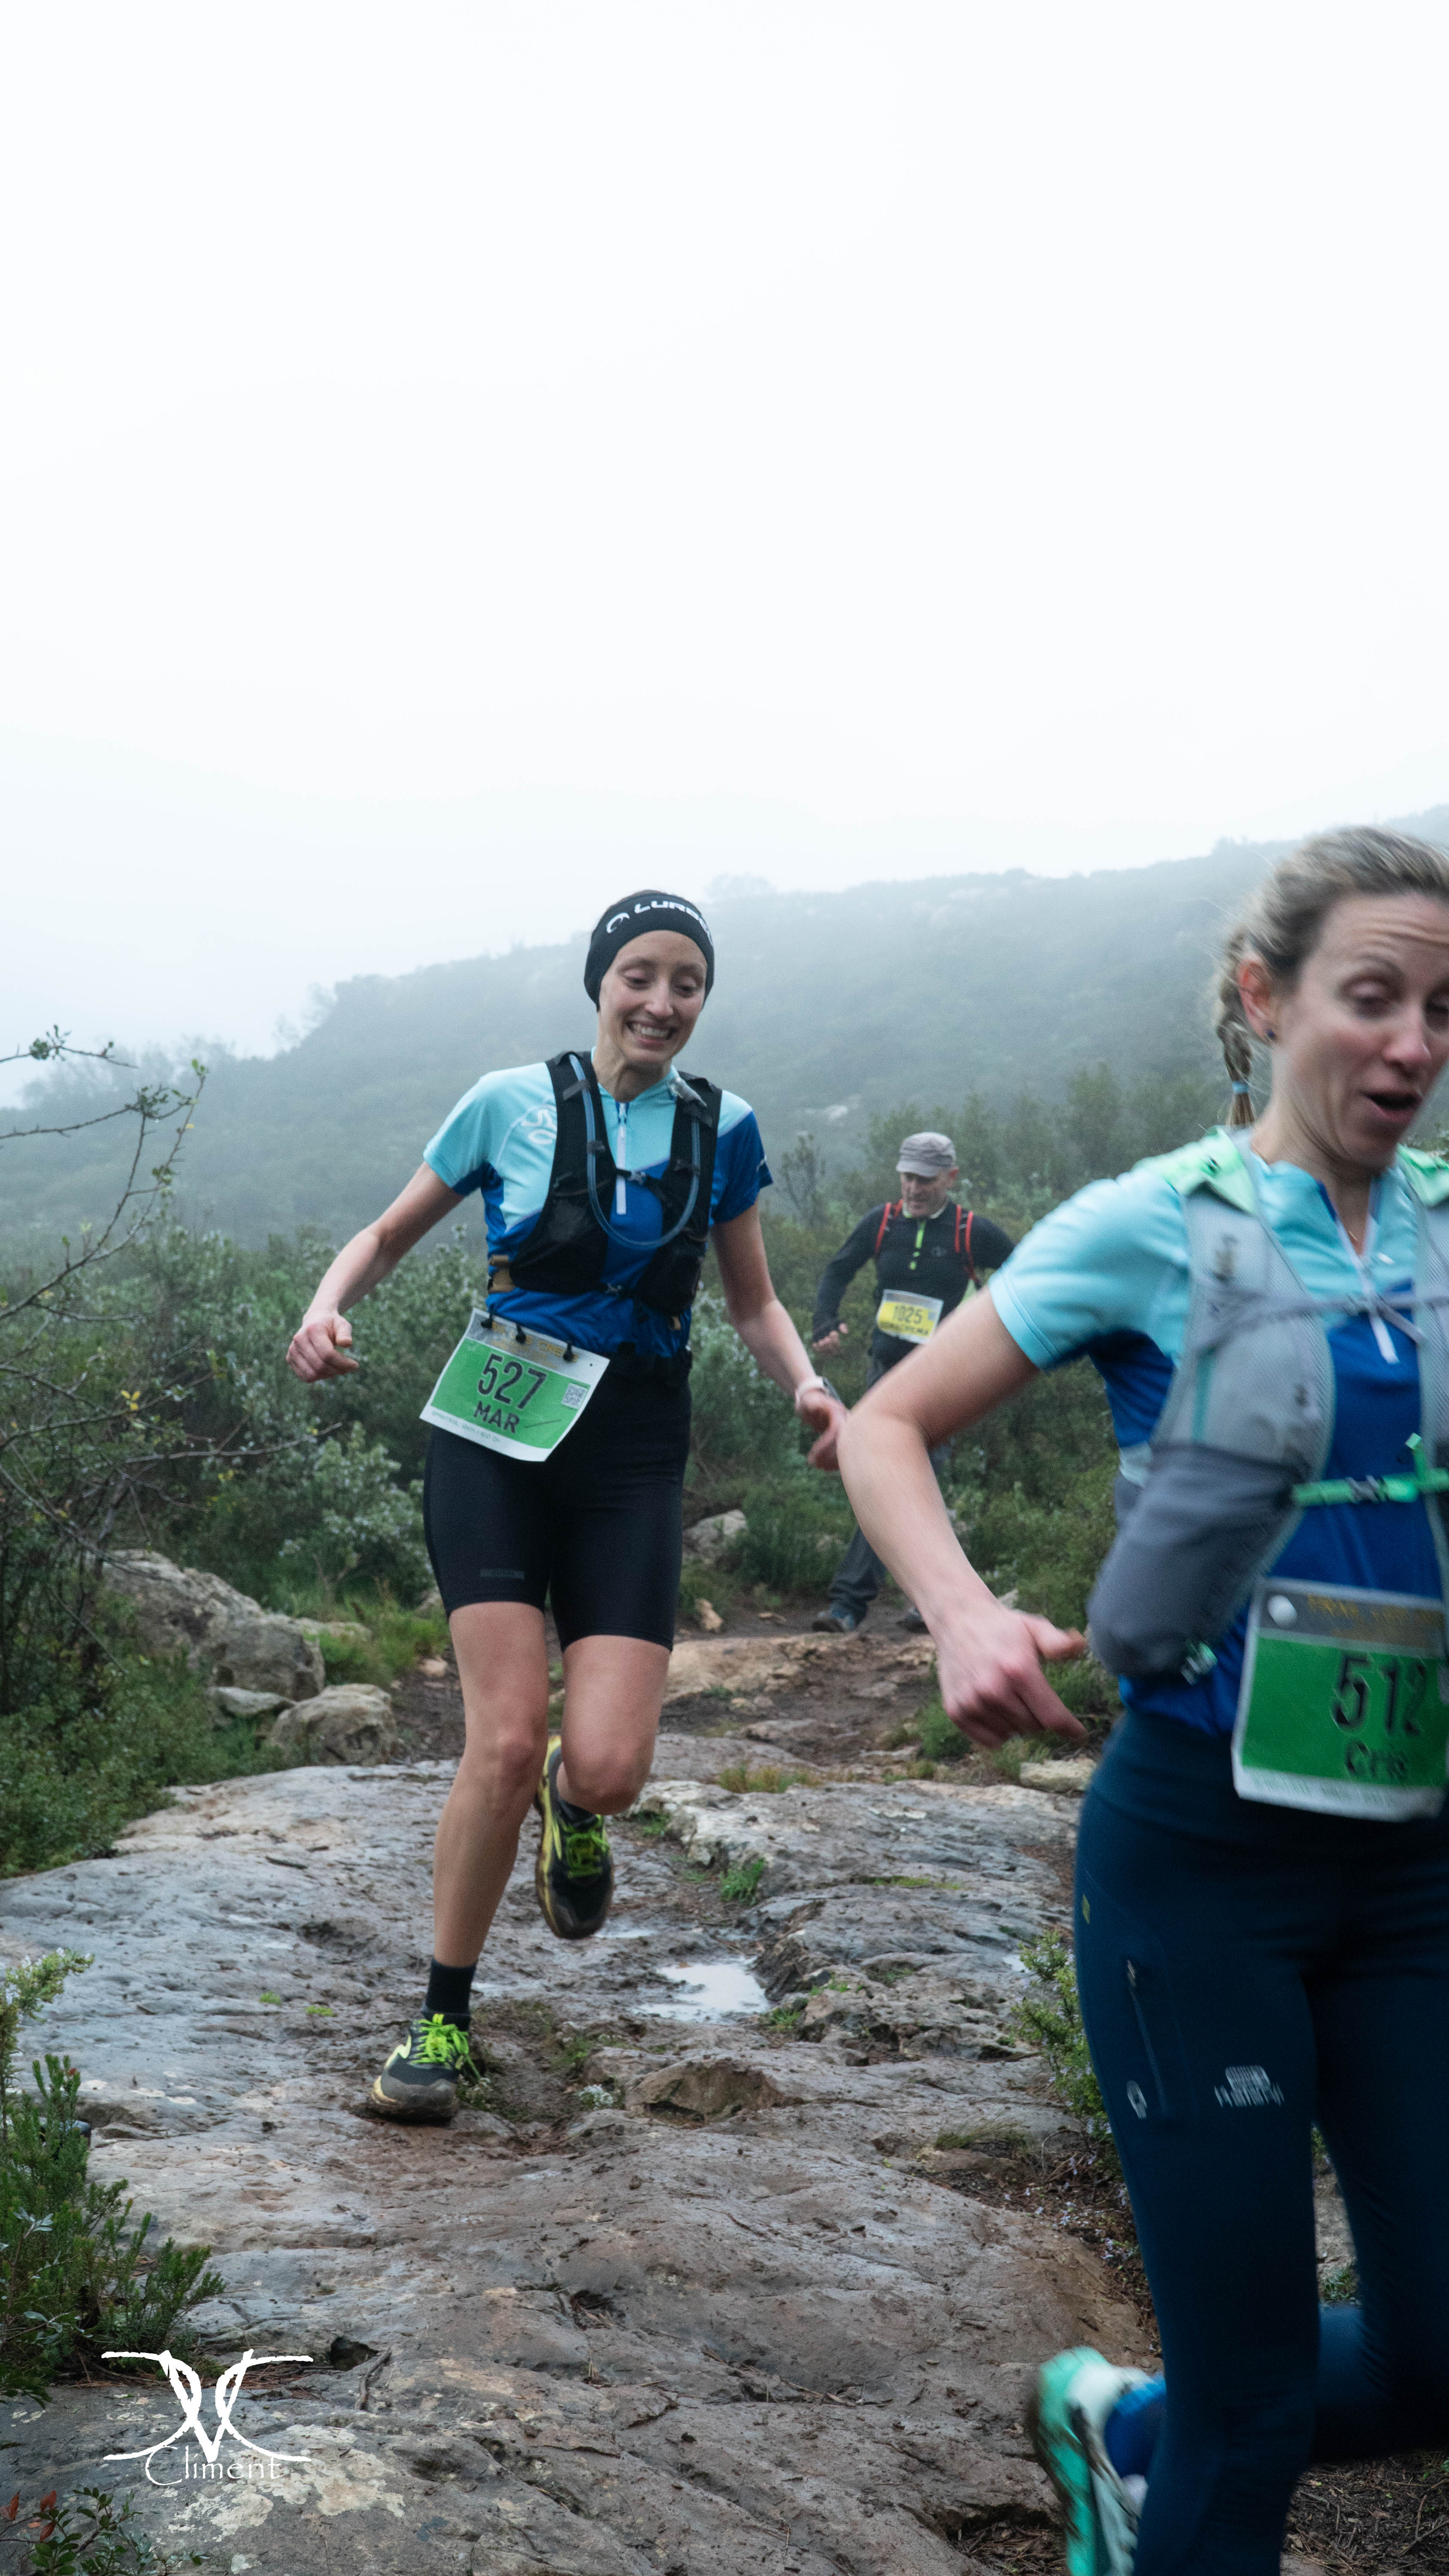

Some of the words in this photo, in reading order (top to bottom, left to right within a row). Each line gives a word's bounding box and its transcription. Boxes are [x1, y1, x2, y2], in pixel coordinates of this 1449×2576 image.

[477, 1353, 548, 1410] 527
[473, 1400, 520, 1434] MAR
[1332, 1654, 1428, 1735] 512
